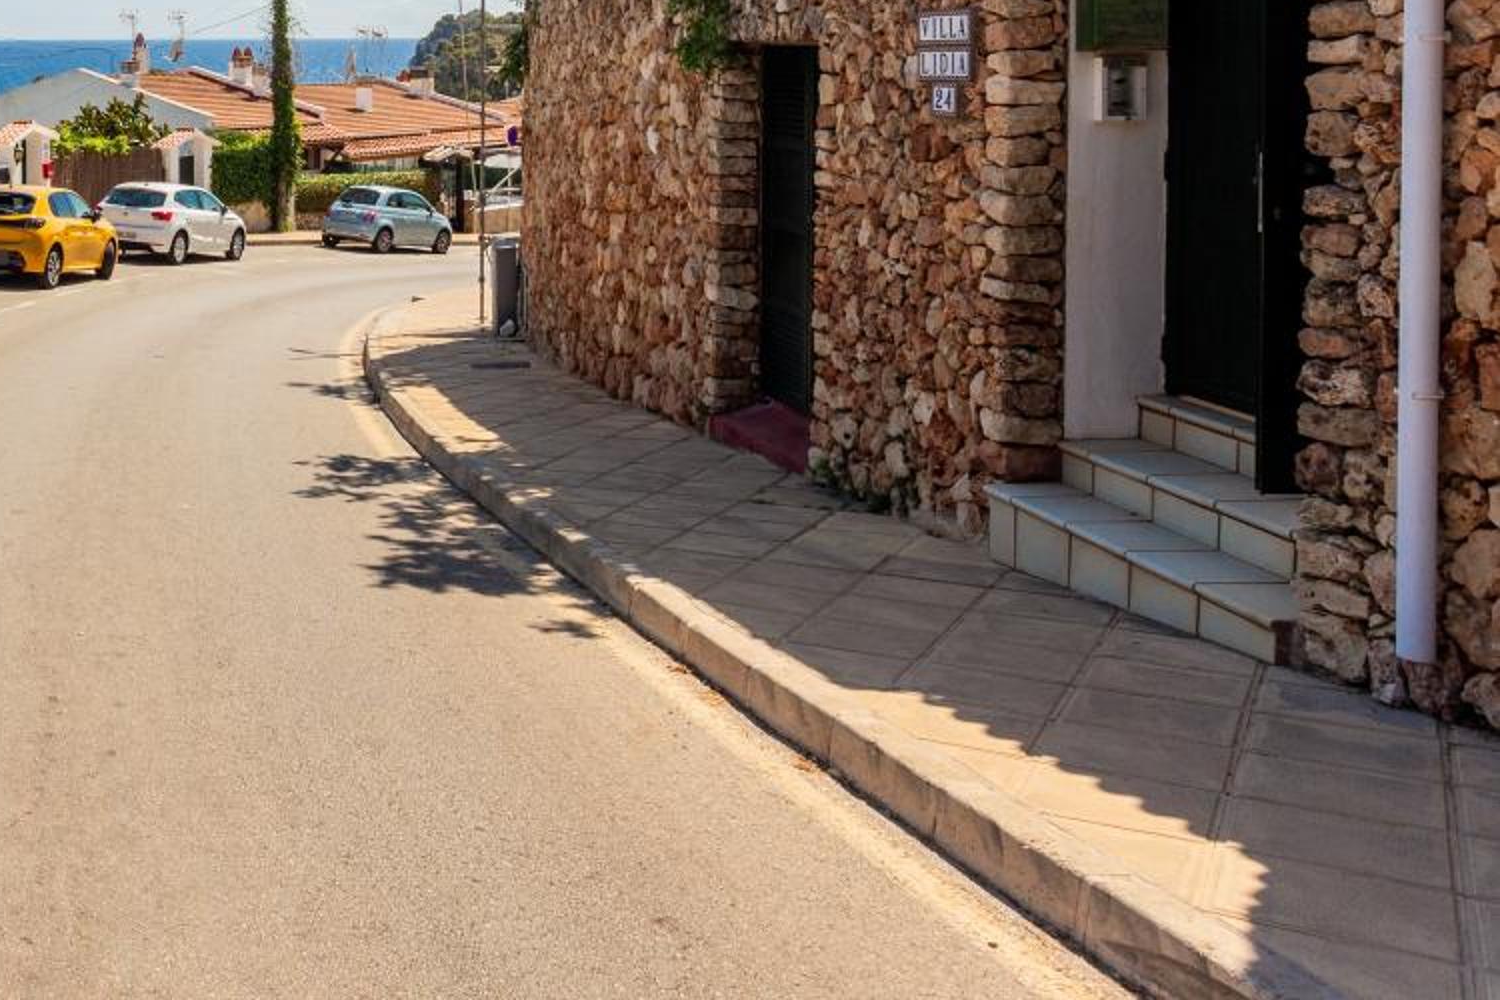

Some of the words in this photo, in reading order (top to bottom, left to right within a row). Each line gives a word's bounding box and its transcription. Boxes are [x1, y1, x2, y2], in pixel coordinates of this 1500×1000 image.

[921, 16, 965, 39] VILLA
[921, 53, 965, 75] LIDIA
[935, 88, 951, 110] 24
